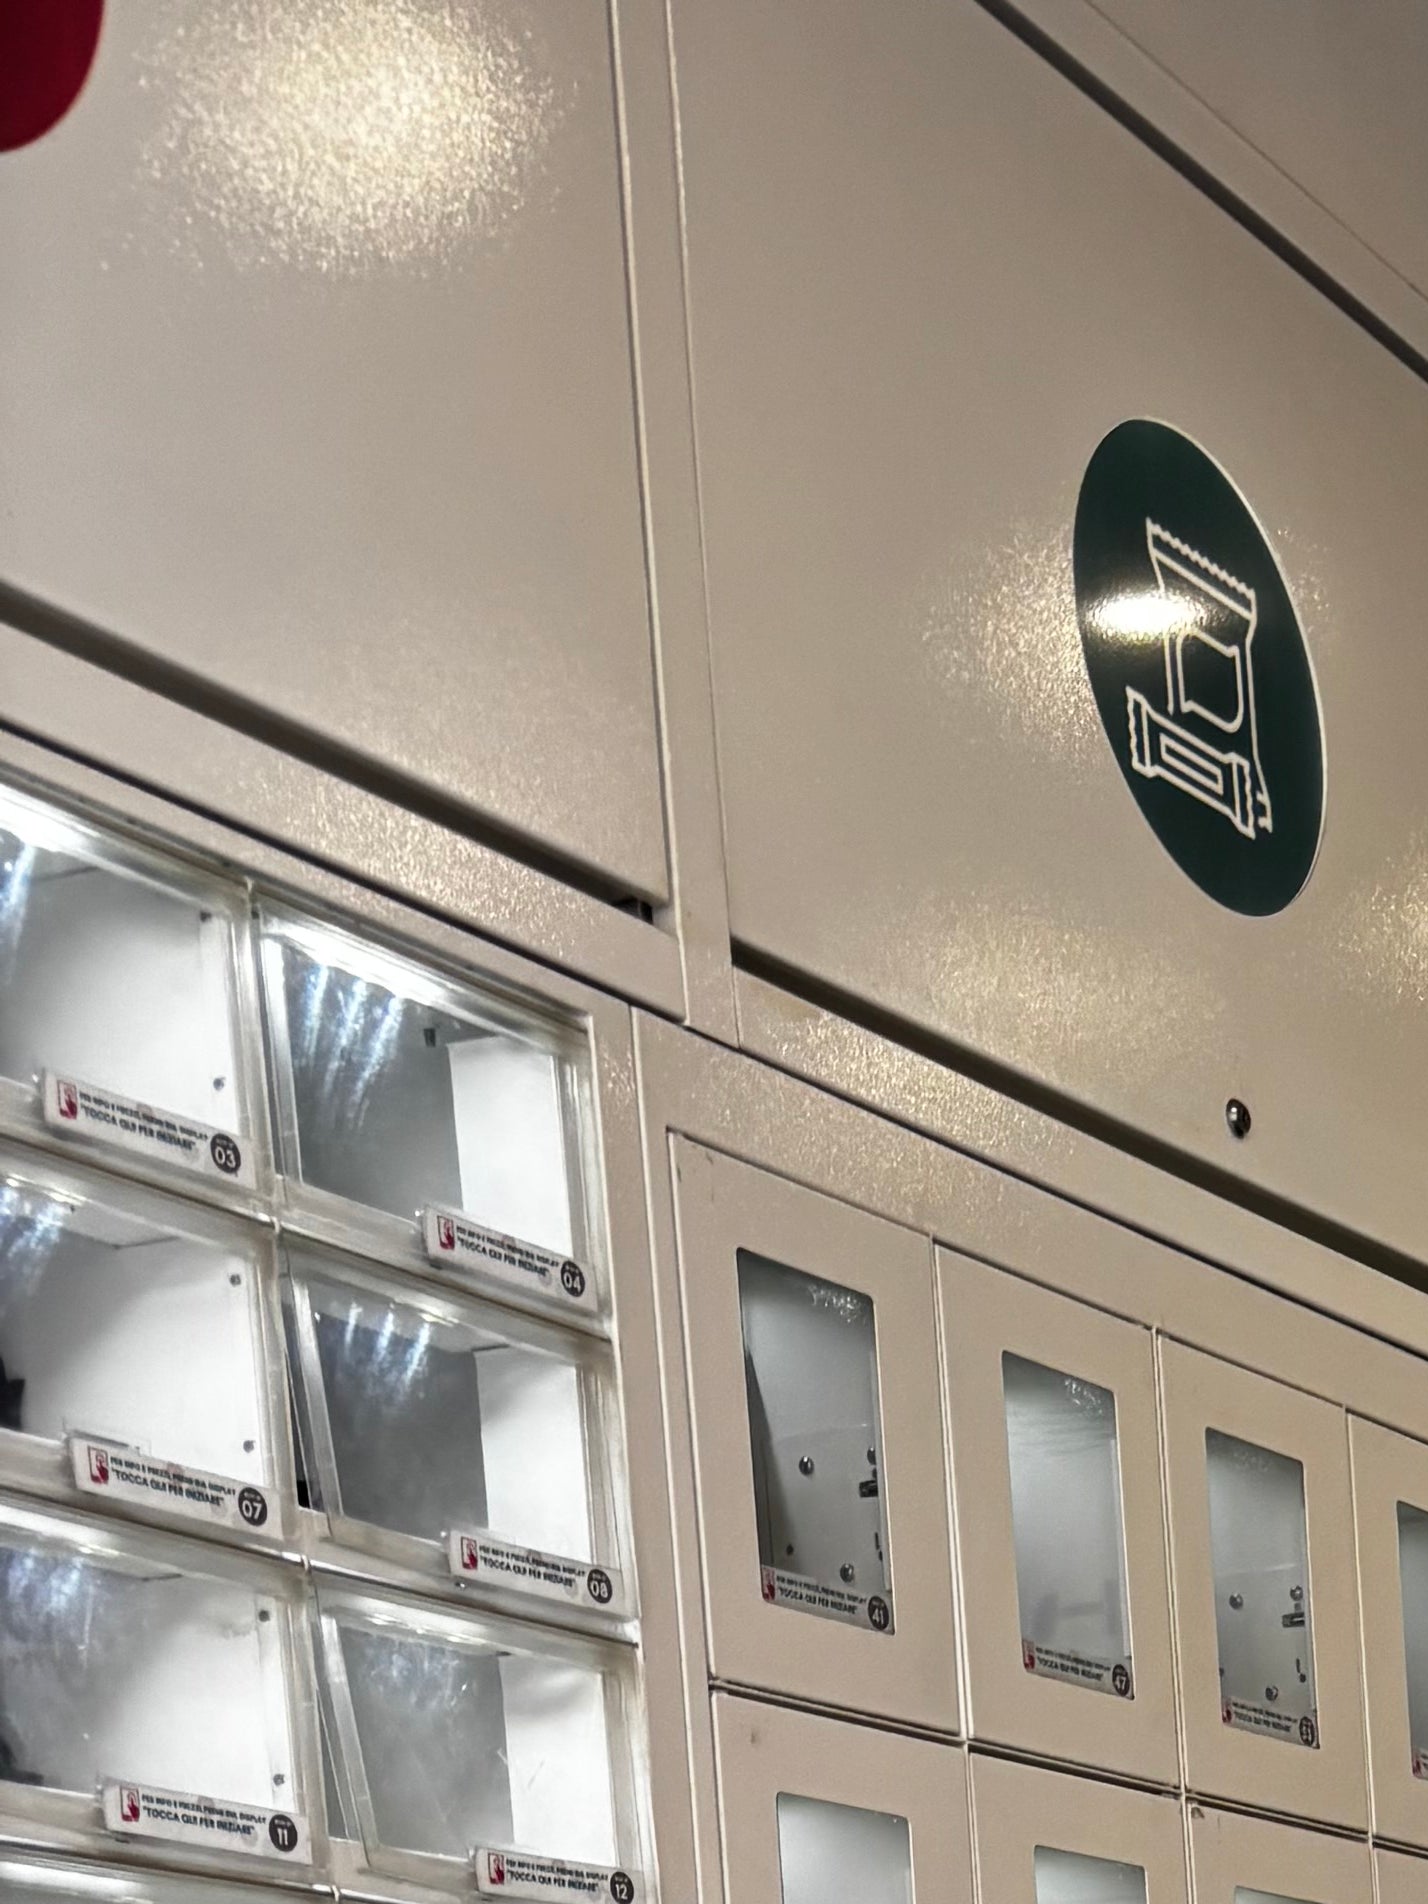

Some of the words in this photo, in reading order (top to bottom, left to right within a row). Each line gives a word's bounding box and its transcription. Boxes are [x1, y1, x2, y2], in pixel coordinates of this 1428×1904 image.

[214, 1147, 235, 1169] 03
[563, 1270, 581, 1292] 04
[241, 1499, 263, 1521] 07
[590, 1579, 608, 1599] 08
[276, 1827, 289, 1846] 11
[615, 1882, 627, 1900] 12
